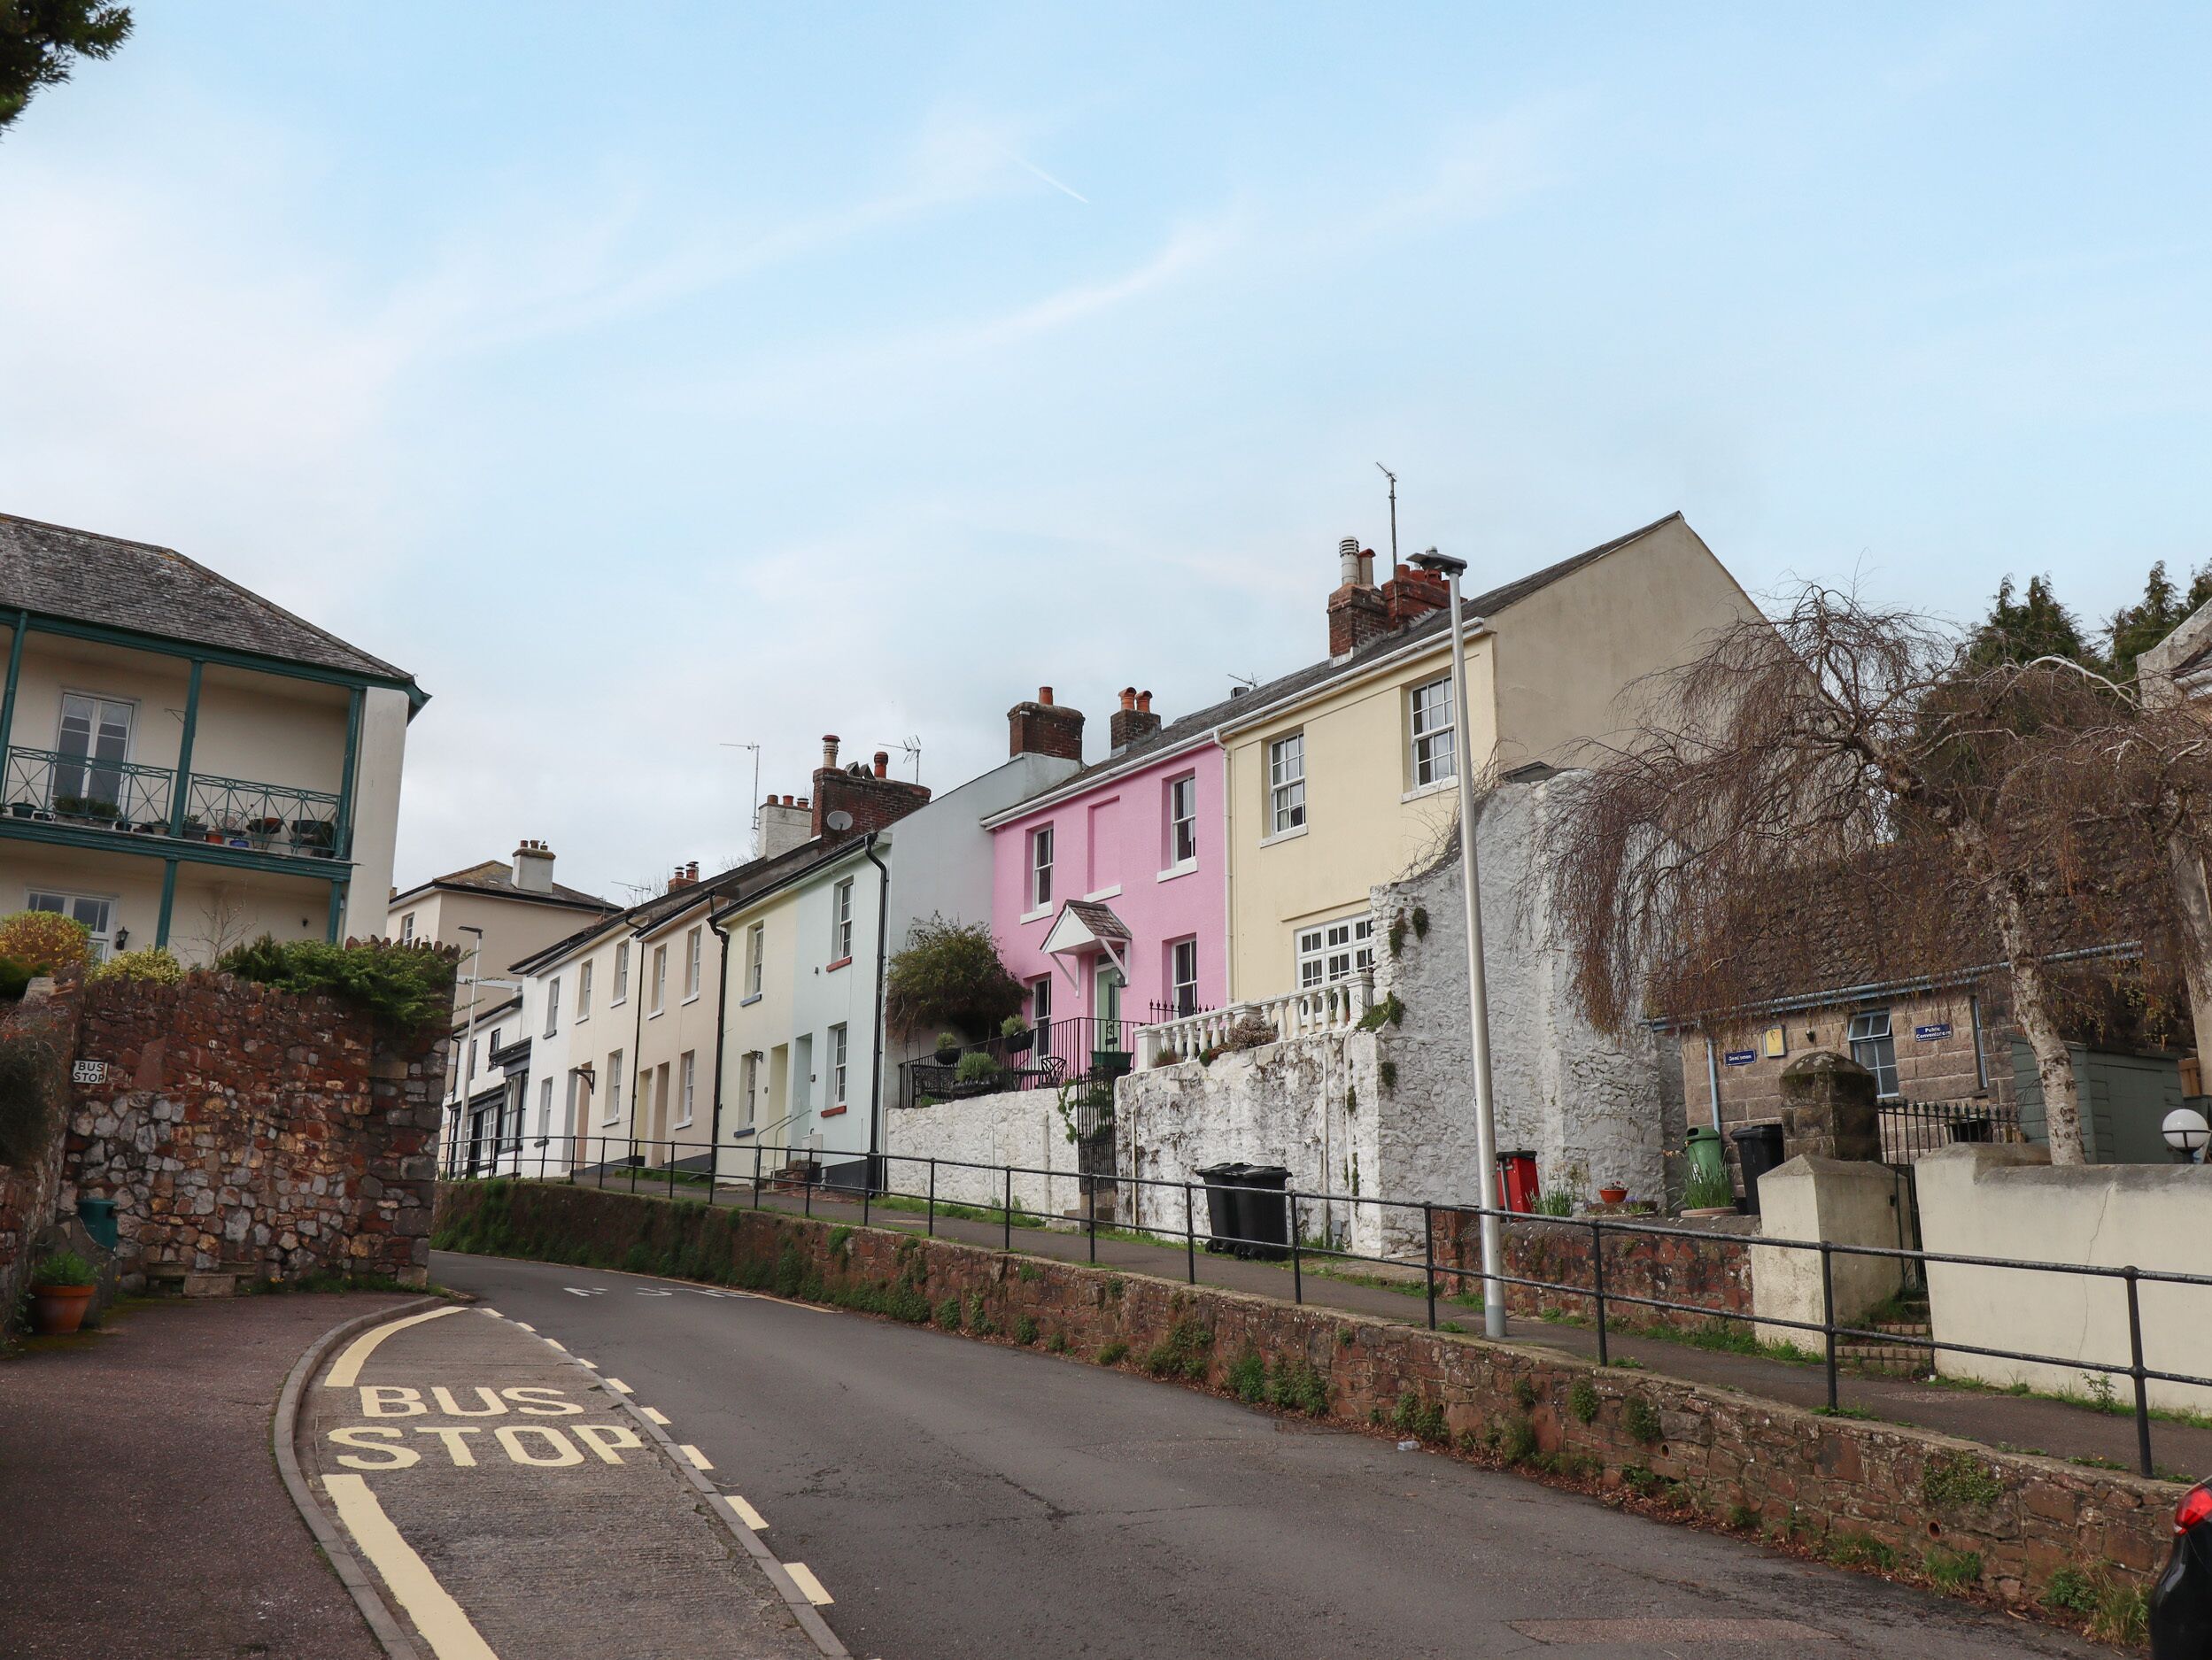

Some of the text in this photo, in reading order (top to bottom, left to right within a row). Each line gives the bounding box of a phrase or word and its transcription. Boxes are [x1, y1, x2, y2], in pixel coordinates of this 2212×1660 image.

[78, 1062, 104, 1071] BUS
[73, 1072, 104, 1082] STOP
[358, 1386, 584, 1417] BUS
[327, 1425, 643, 1470] STOP
